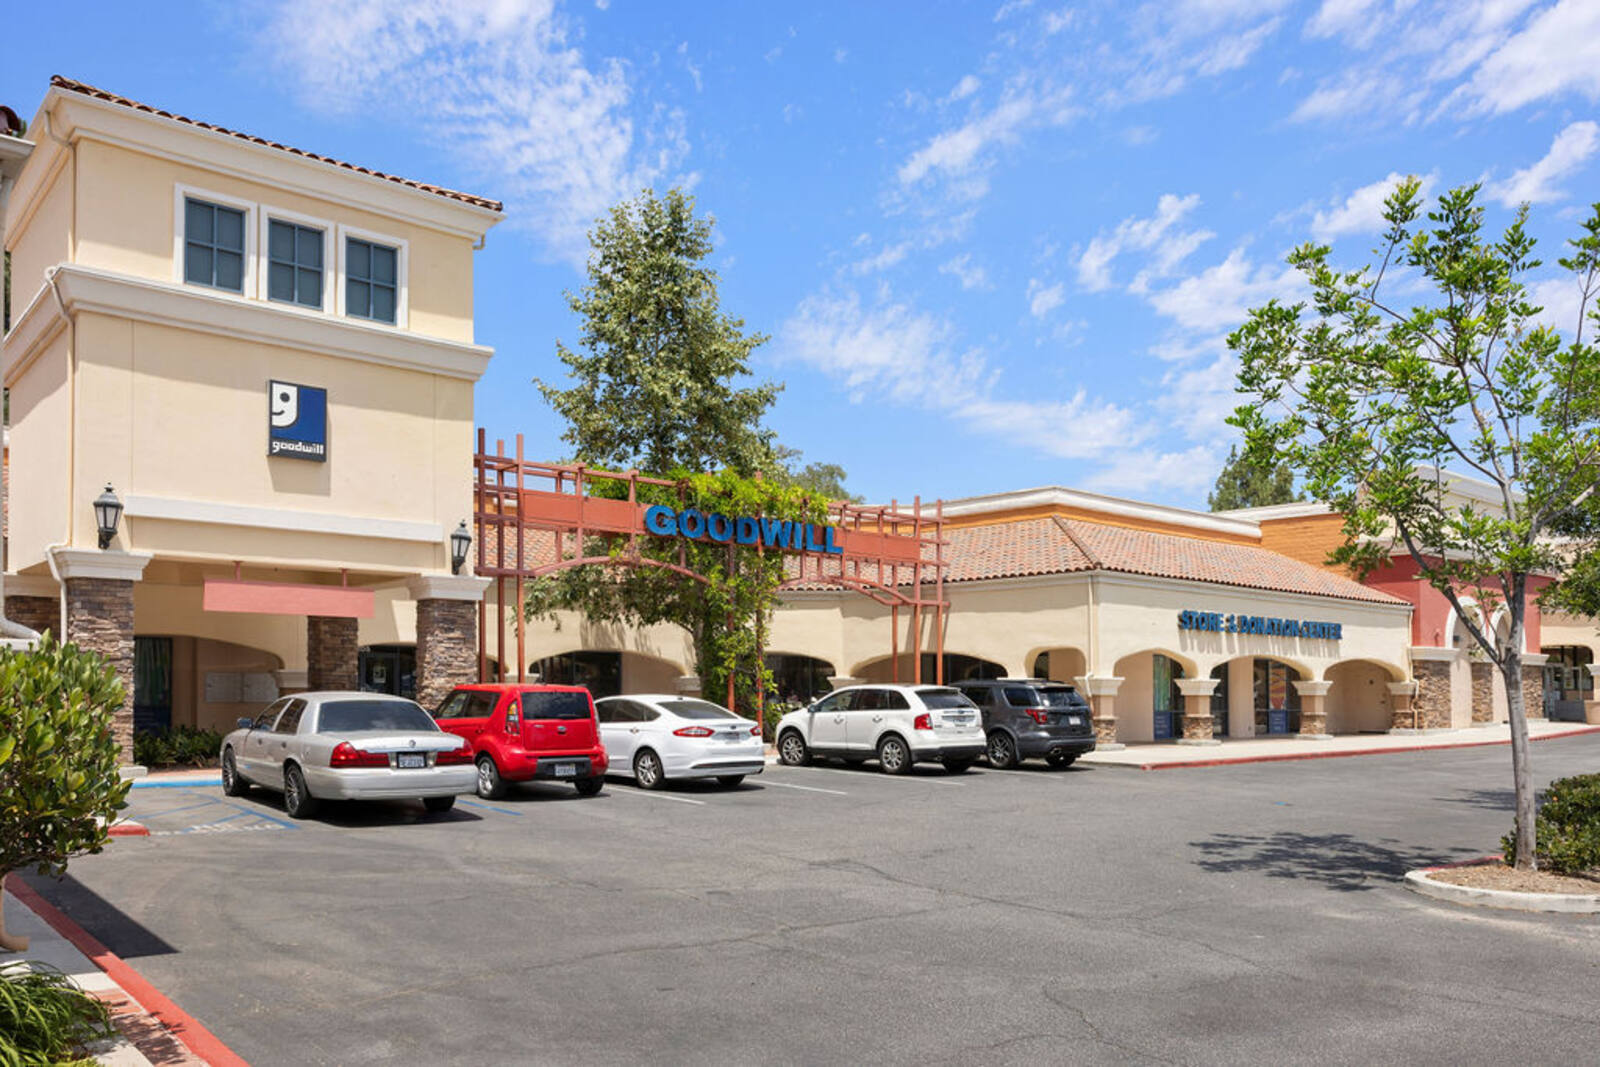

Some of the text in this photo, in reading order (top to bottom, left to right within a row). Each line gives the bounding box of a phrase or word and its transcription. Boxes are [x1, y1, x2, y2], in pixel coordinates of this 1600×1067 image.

[272, 441, 324, 454] goodwill
[646, 505, 843, 554] GOODWILL
[1178, 609, 1342, 640] STORE & DONATION CENTER
